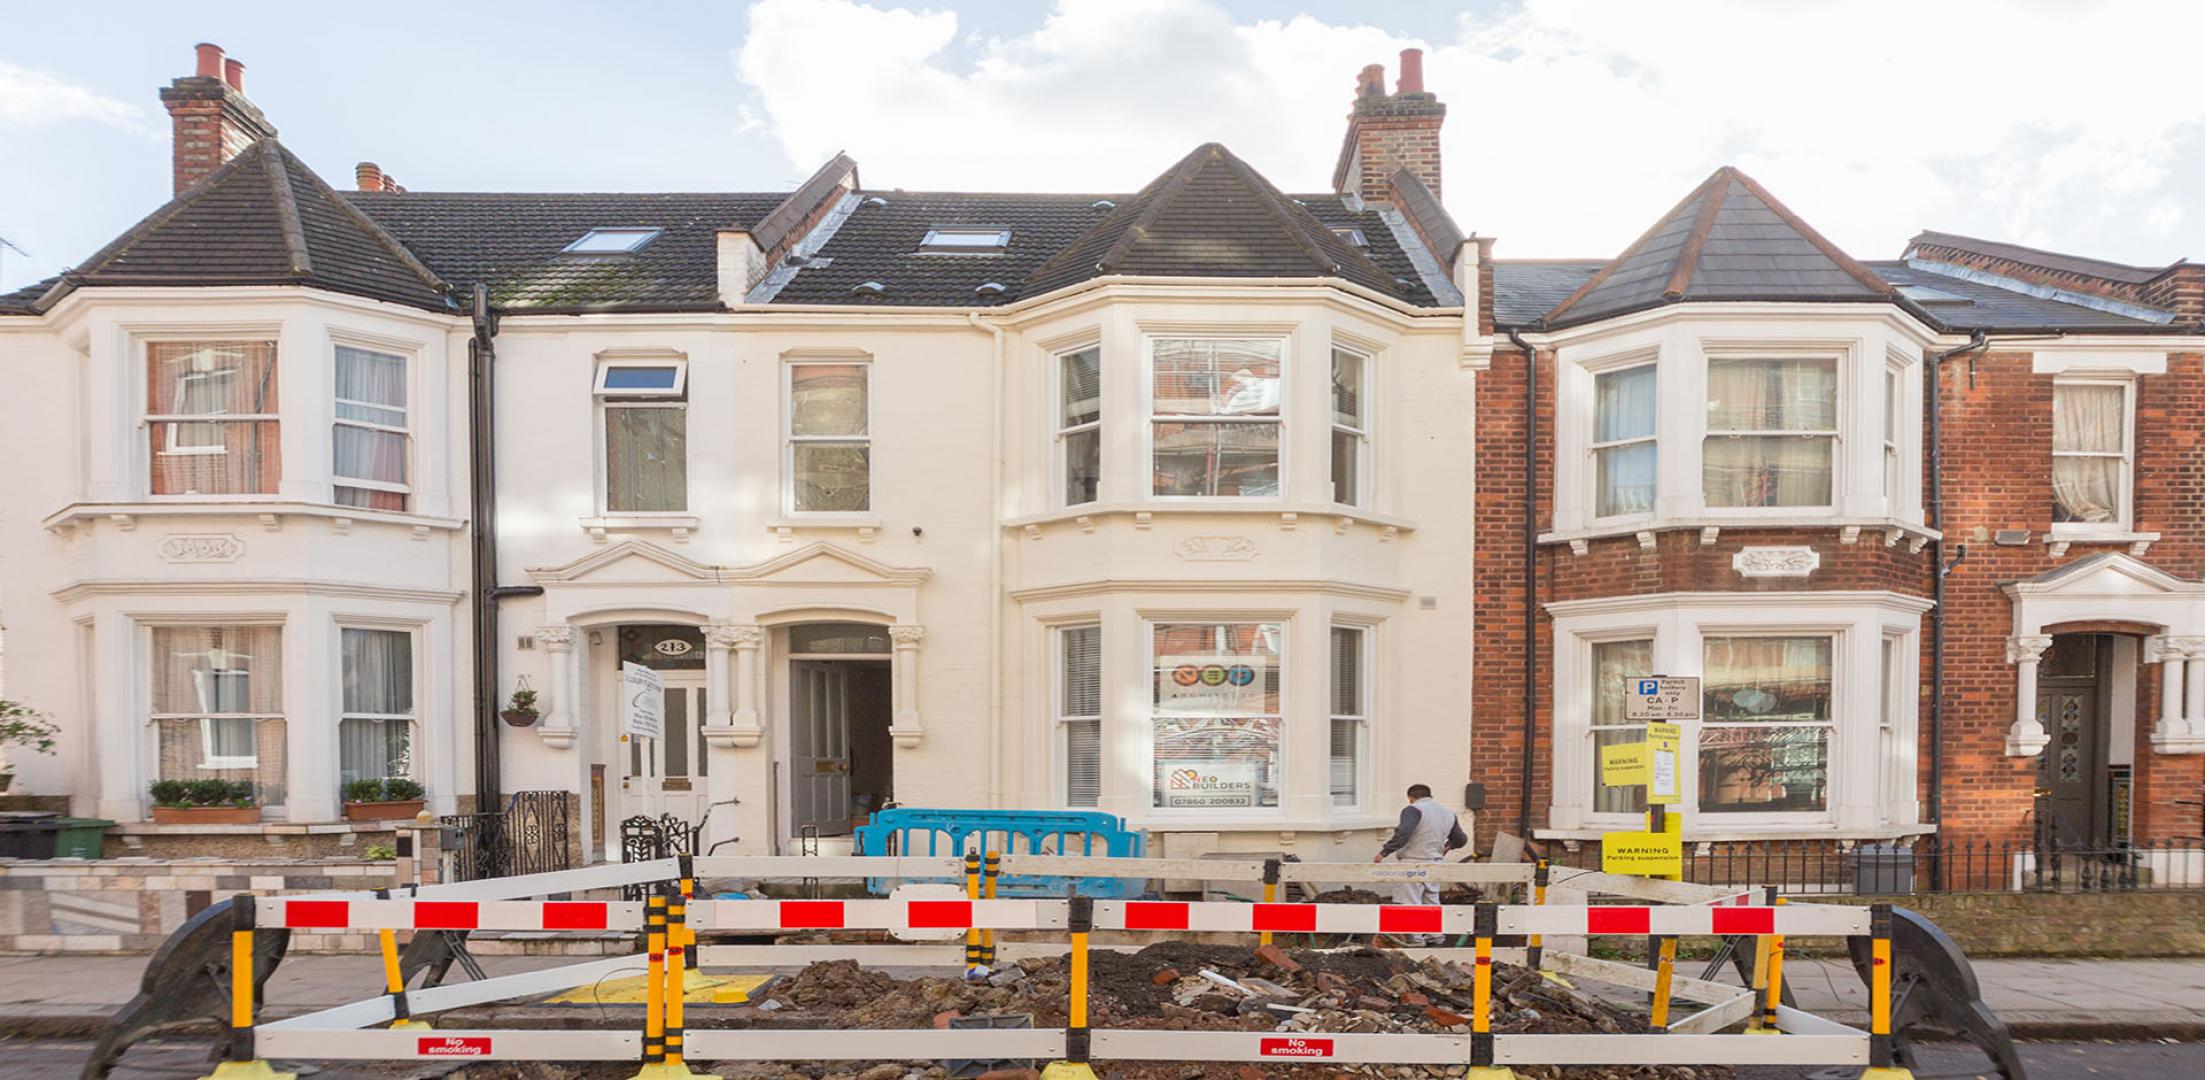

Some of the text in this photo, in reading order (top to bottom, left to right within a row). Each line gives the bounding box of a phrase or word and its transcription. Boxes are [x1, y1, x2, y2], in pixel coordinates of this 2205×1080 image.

[660, 642, 687, 652] 213
[445, 1038, 464, 1047] No
[1288, 1039, 1306, 1047] No
[428, 1046, 481, 1055] smoking
[1271, 1047, 1323, 1057] smoking
